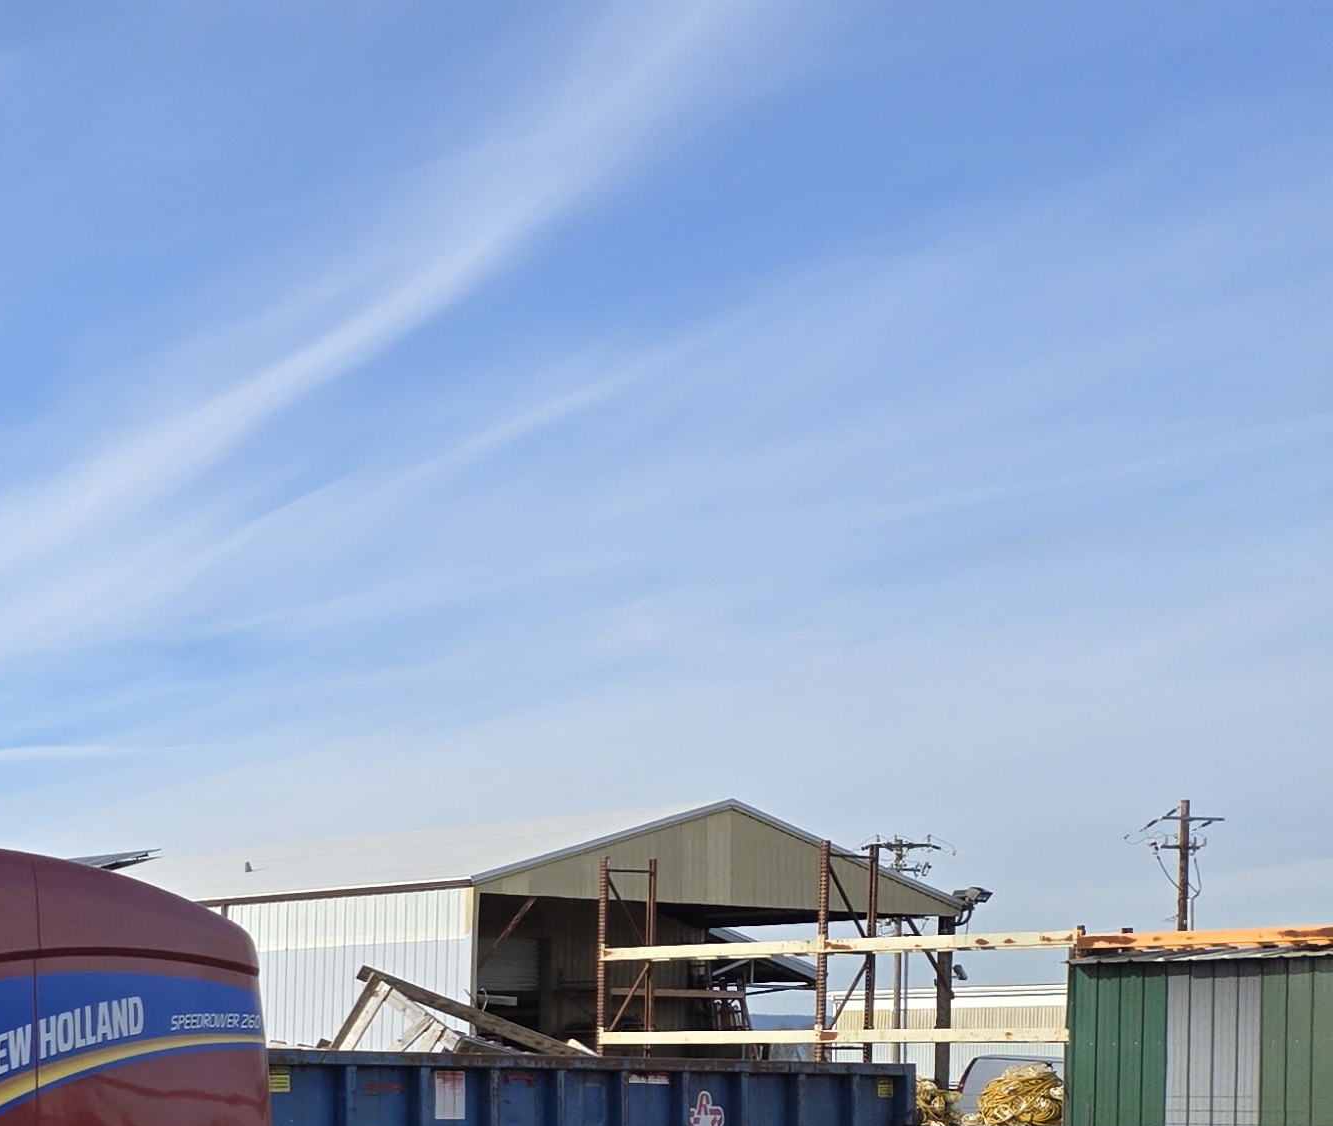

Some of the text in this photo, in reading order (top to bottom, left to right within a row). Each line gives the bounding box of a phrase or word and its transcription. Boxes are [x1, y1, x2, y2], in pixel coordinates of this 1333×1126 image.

[39, 996, 144, 1060] HOLLAND
[170, 1013, 261, 1031] SPEEDROWER 260
